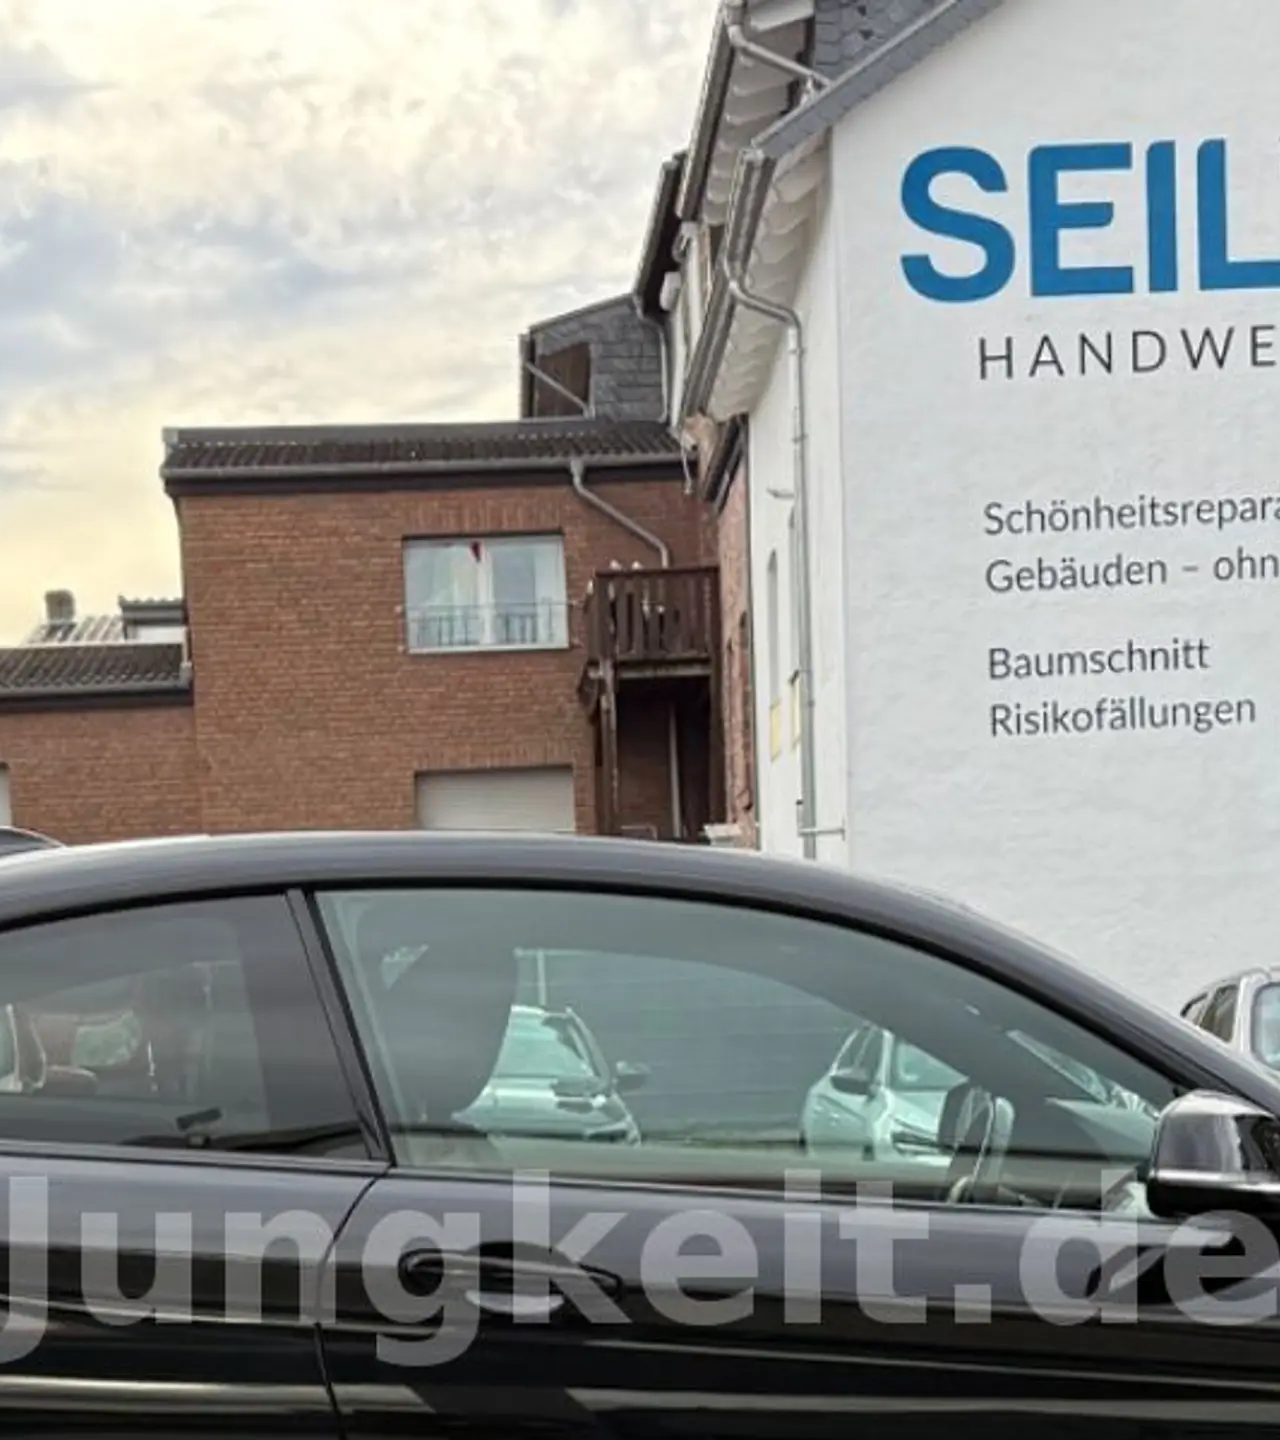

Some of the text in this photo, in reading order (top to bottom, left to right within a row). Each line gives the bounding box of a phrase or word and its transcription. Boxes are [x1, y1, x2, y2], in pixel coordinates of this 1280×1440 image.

[985, 553, 1167, 593] Gebäuden
[988, 637, 1210, 680] Baumschnitt
[990, 695, 1256, 738] Risikofällungen
